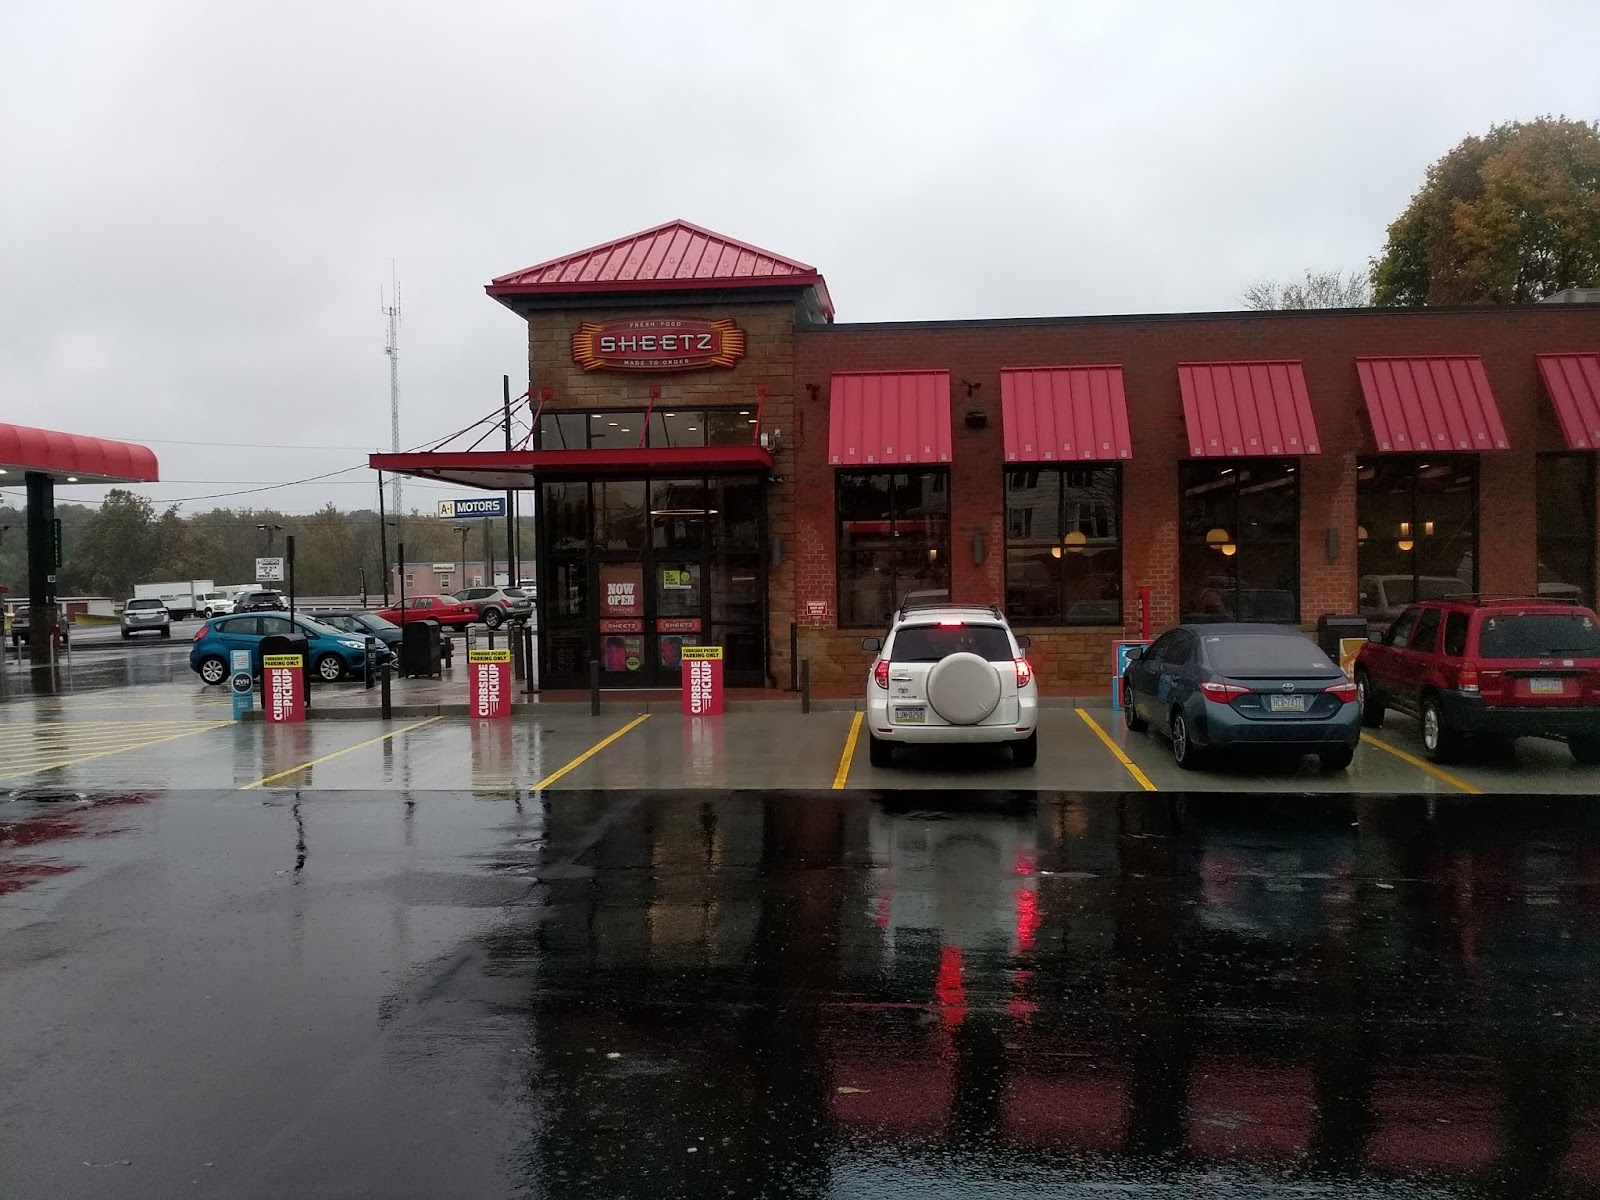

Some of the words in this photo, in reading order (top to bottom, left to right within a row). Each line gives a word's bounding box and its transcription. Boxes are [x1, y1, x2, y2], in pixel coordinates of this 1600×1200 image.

[600, 334, 713, 352] SHEETZ
[457, 500, 501, 513] MOTORS
[607, 583, 635, 594] NOW
[607, 595, 635, 606] OPEN
[272, 669, 283, 721] CURBSIDE
[282, 668, 293, 707] PICKUP
[478, 664, 489, 716] CURBSIDE
[489, 664, 500, 702] PICKUP
[691, 661, 701, 713] CURBSIDE
[701, 661, 712, 699] PICKUP
